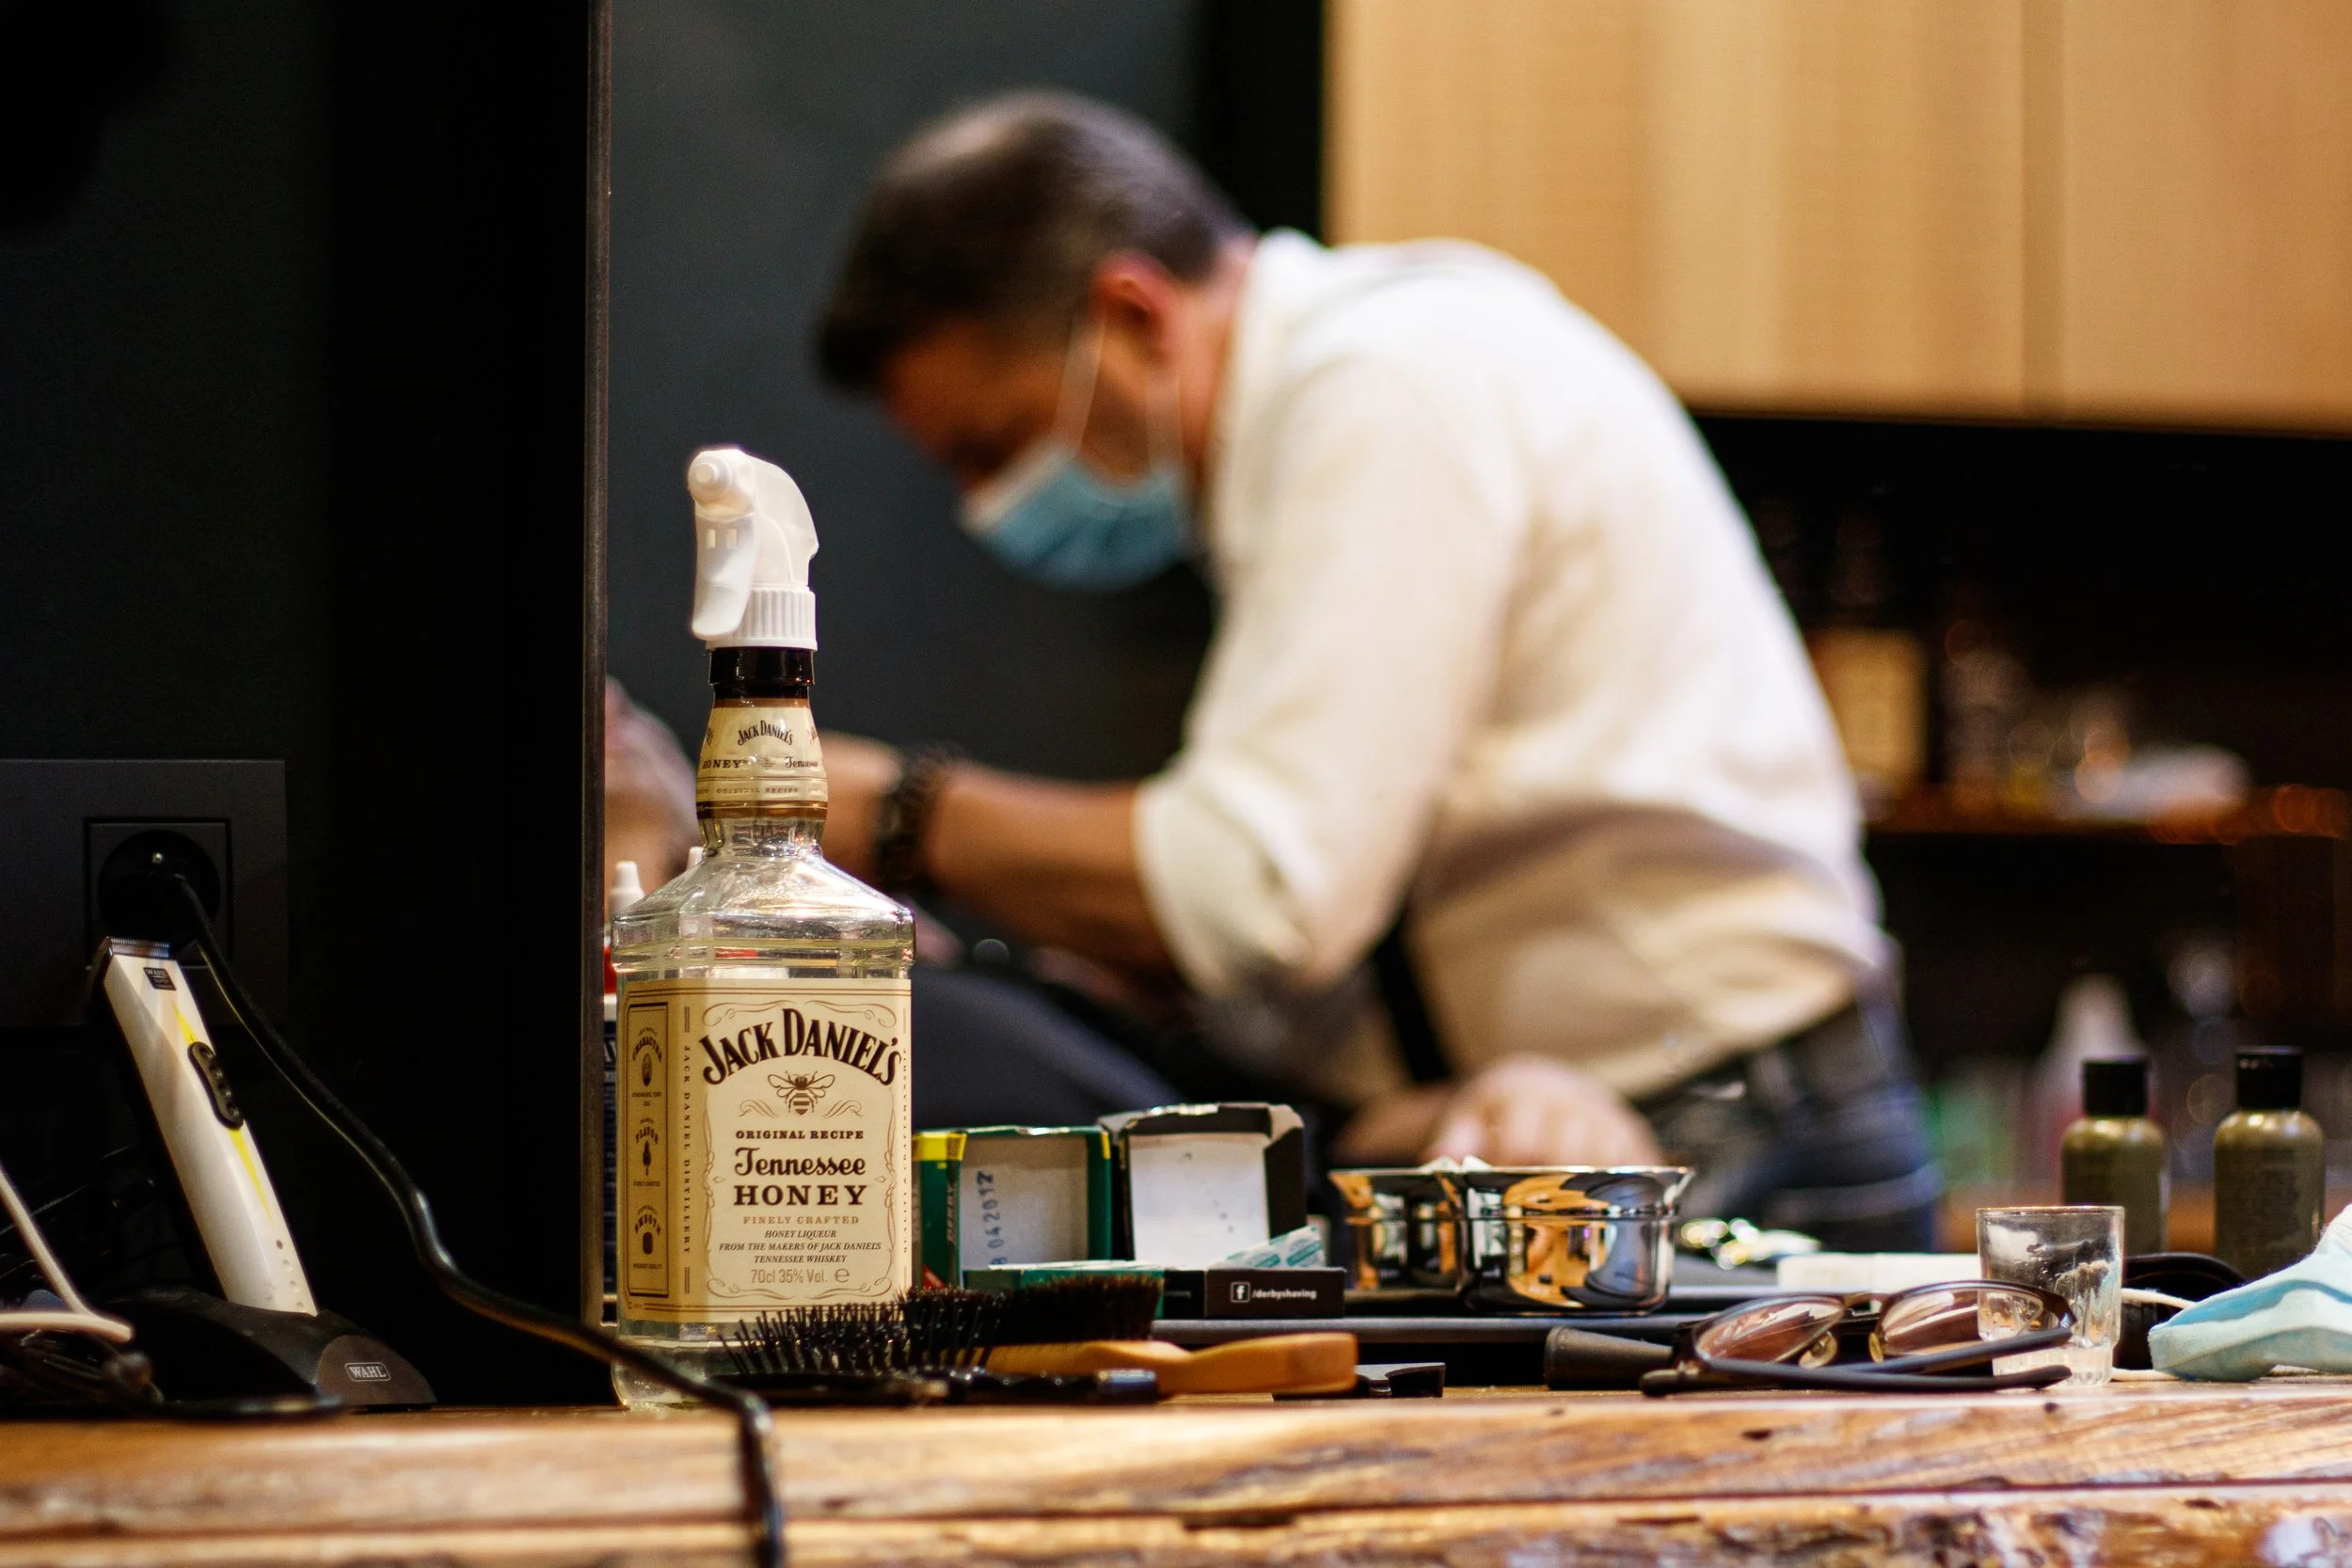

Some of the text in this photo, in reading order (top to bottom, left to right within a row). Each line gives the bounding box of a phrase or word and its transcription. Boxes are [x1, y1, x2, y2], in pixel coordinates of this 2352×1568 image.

[738, 724, 759, 746] JACK
[698, 1007, 902, 1085] JACK DANIEL'S
[736, 1131, 864, 1139] ORIGINAL RECIPE
[734, 1147, 866, 1176] Tennessee
[733, 1185, 867, 1205] HONEY
[742, 1216, 859, 1225] FINELY CRAFTED
[798, 1230, 836, 1240] LIQUEUR
[748, 1243, 766, 1251] THE
[769, 1243, 805, 1251] MAKERS
[807, 1243, 819, 1251] OF
[819, 1243, 842, 1252] JACK
[752, 1270, 776, 1283] 70cl
[779, 1270, 803, 1283] 35%
[807, 1270, 828, 1283] Vol.
[349, 1367, 387, 1378] WAHL
